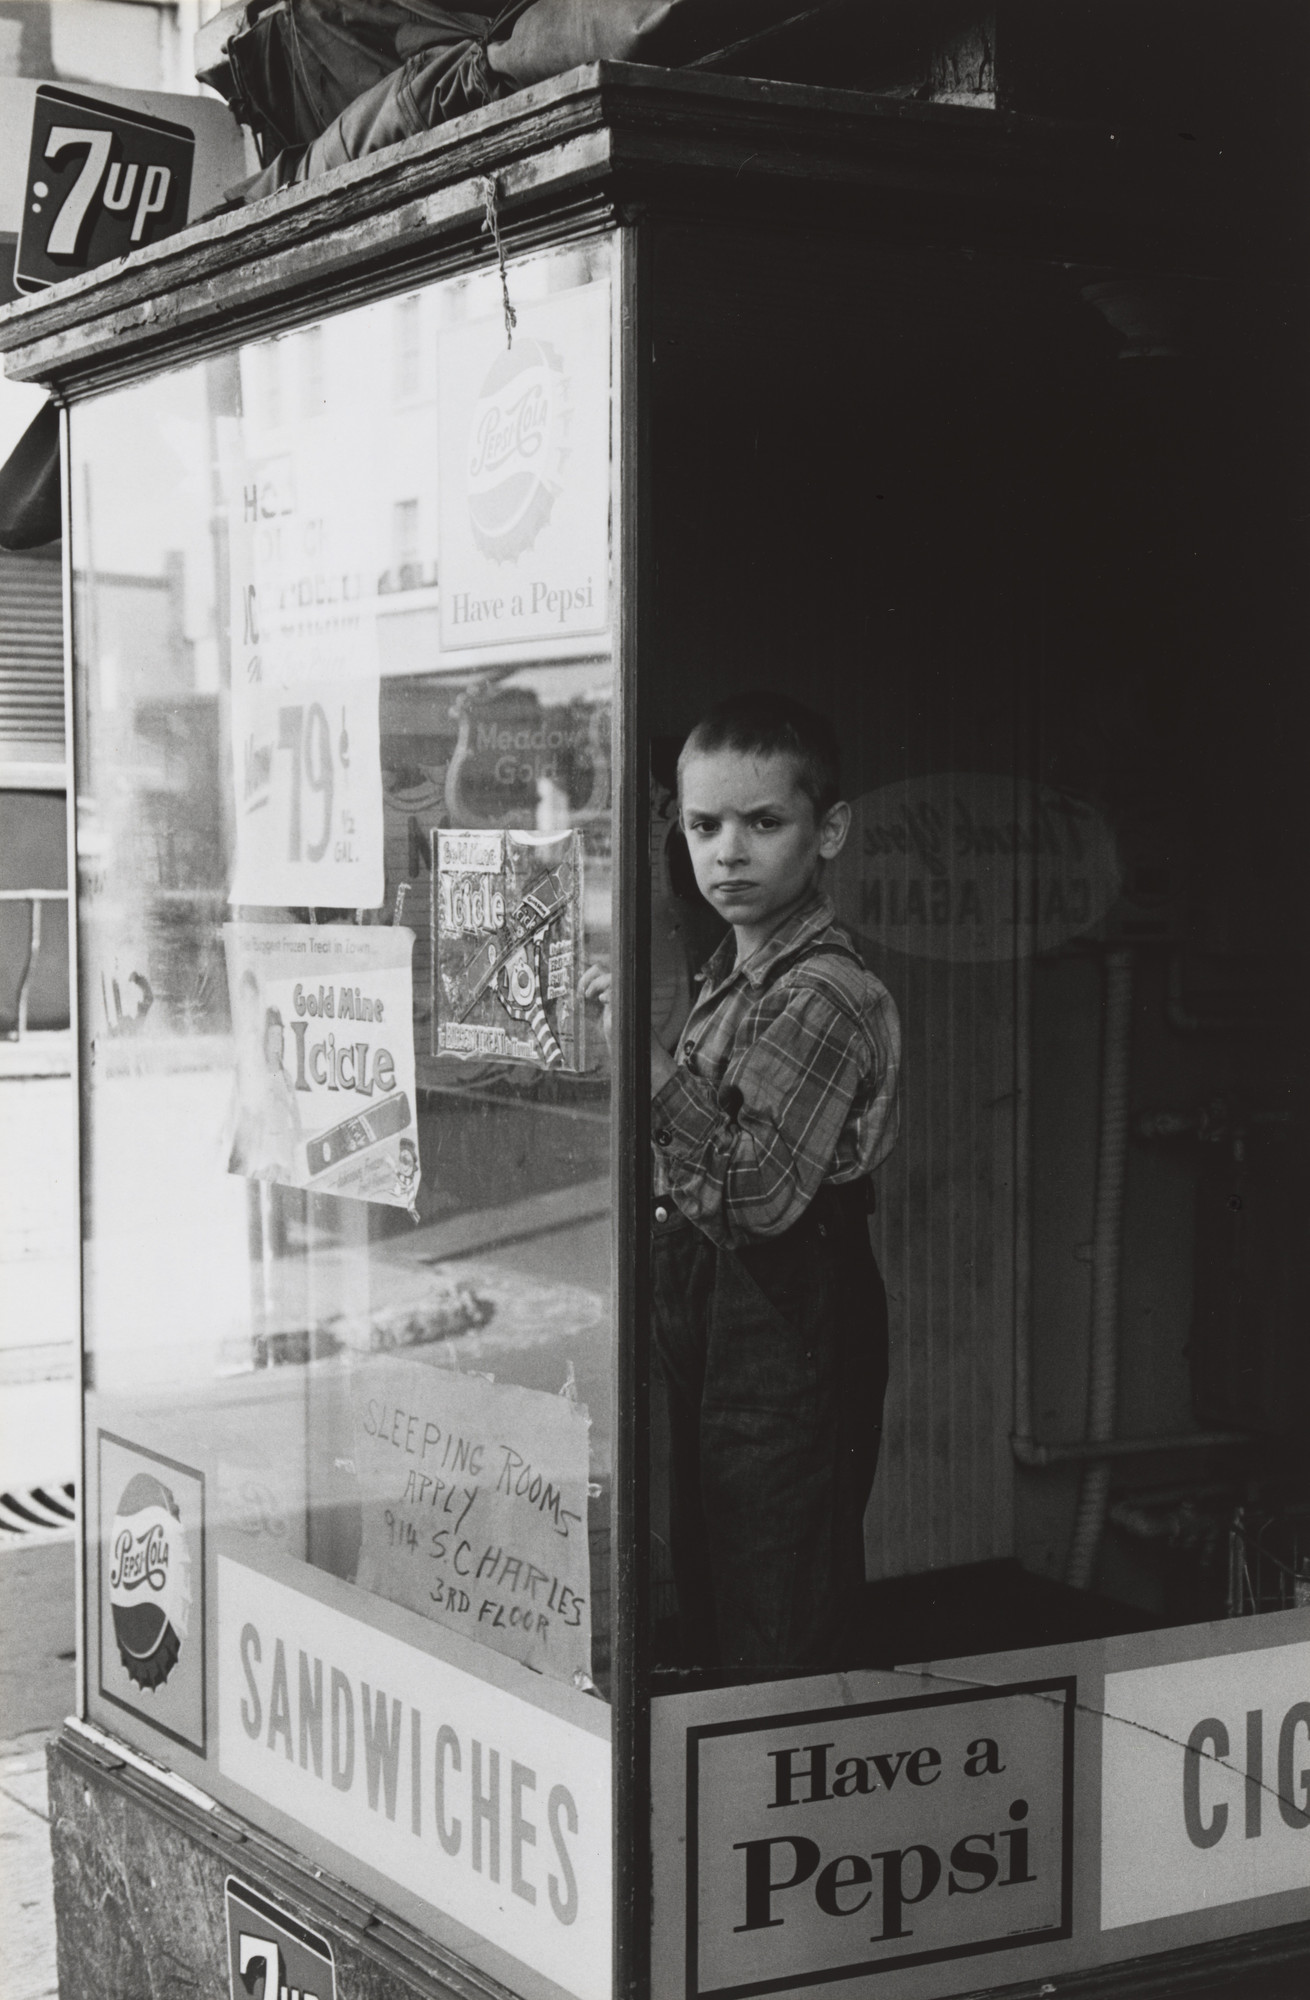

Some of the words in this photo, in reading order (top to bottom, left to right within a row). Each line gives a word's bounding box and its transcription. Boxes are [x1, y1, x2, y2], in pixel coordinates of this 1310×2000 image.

[451, 592, 505, 625] Have
[511, 593, 524, 617] a
[530, 576, 594, 623] Pepsi
[440, 869, 507, 935] Icicle
[293, 983, 335, 1019] Gold
[337, 987, 384, 1023] Mine
[362, 1398, 485, 1476] SLEEPING
[496, 1444, 582, 1538] ROOMS
[403, 1469, 479, 1535] APPLY
[429, 1577, 470, 1613] 3RD
[477, 1599, 550, 1641] FLOOR
[239, 1622, 580, 1927] SANDWICHES
[766, 1741, 943, 1809] Have
[962, 1737, 1007, 1777] a
[732, 1798, 1038, 1943] Pepsi
